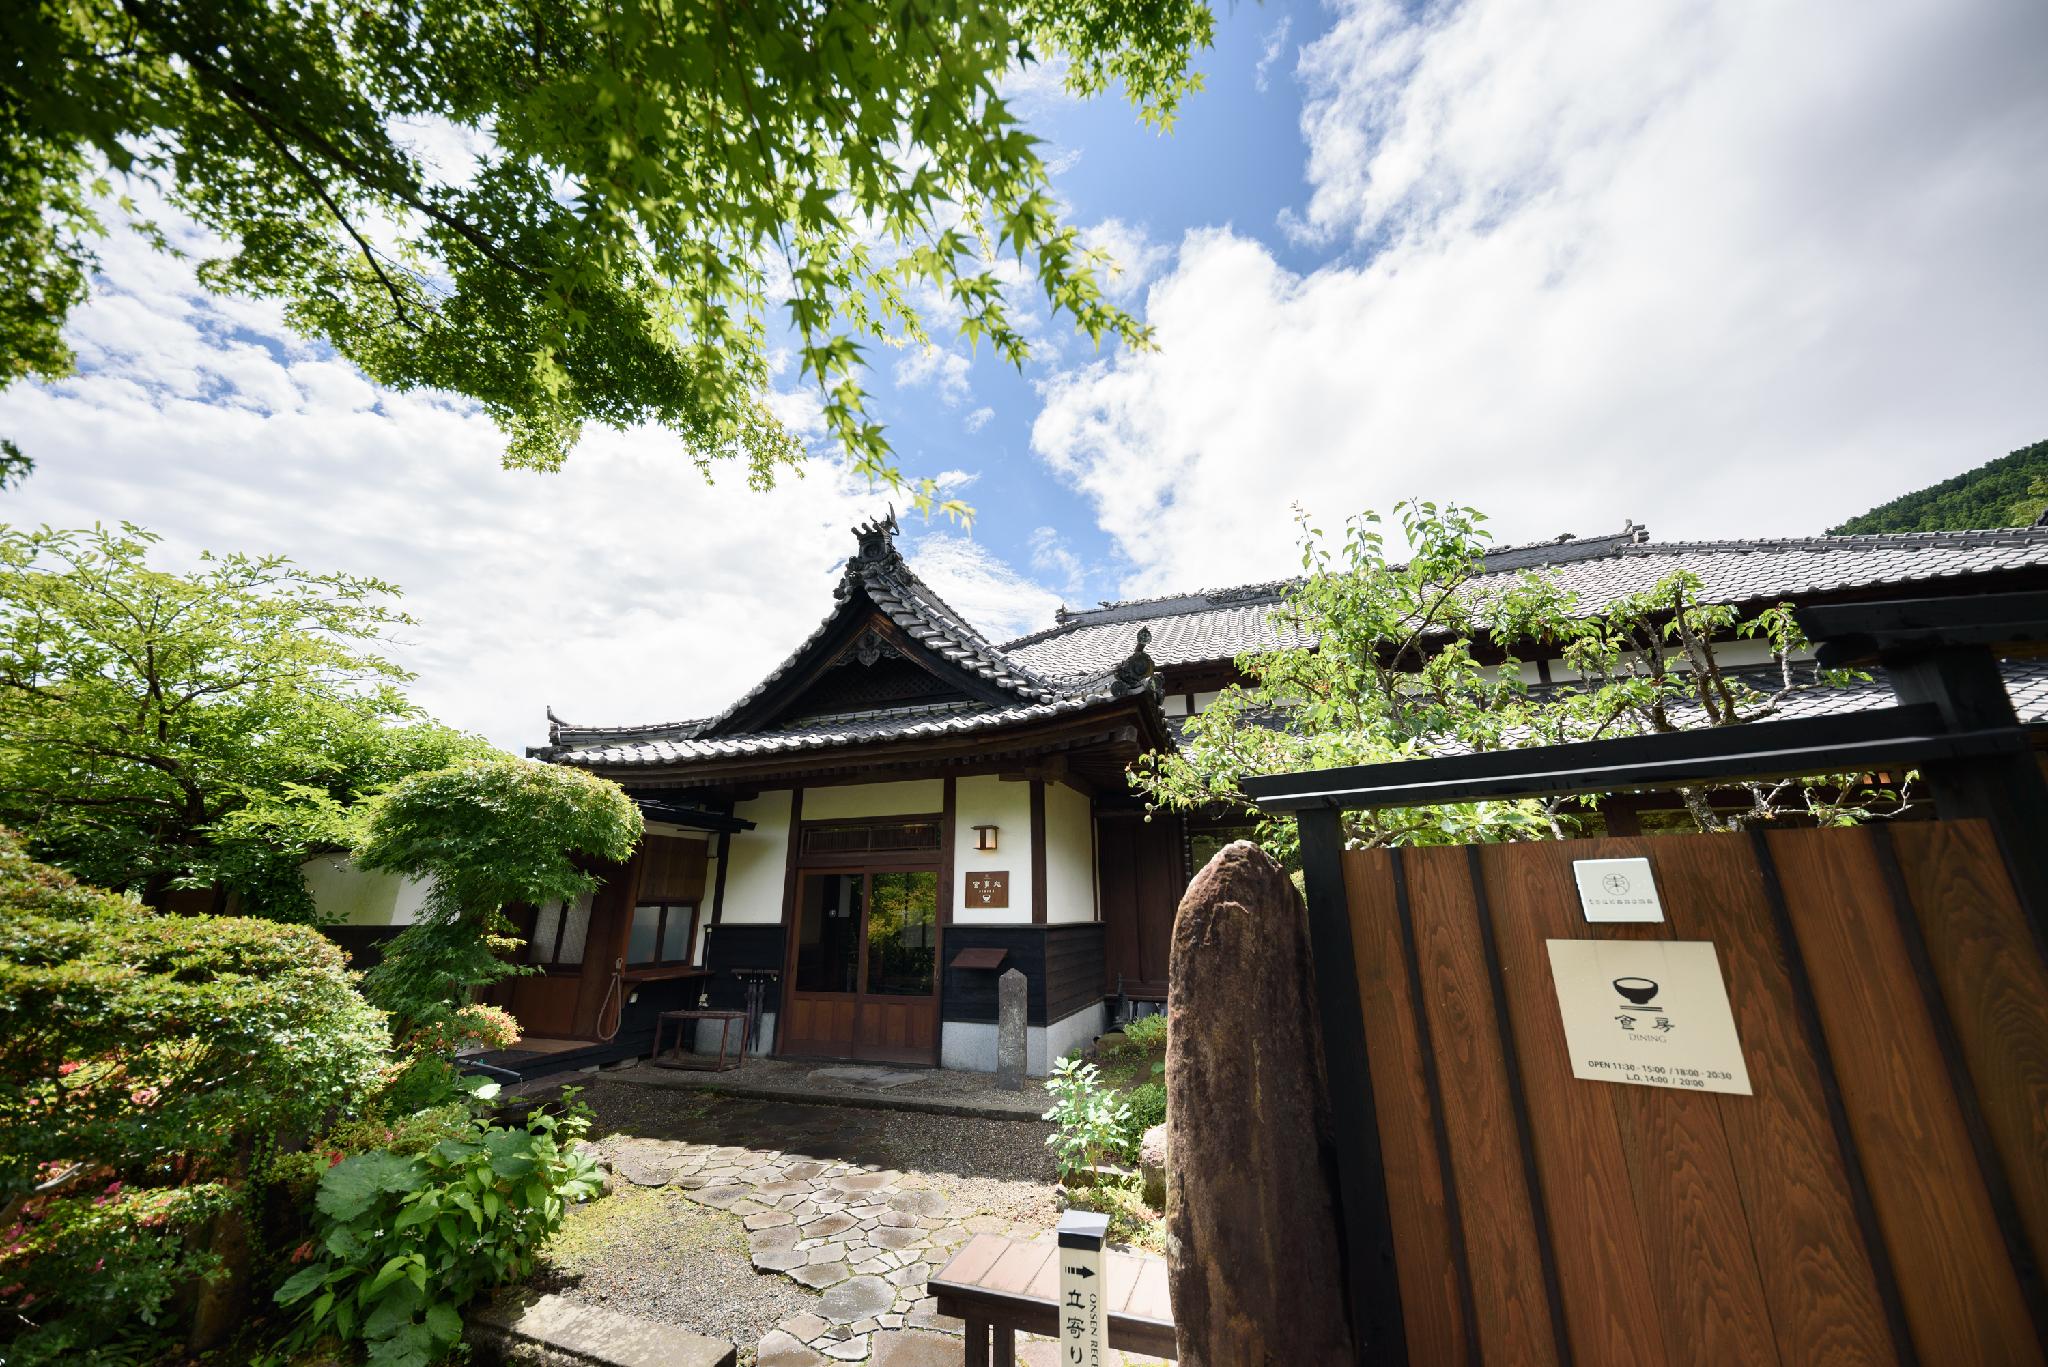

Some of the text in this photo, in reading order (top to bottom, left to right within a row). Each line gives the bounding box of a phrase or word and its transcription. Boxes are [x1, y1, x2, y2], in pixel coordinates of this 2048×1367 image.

[1628, 1033, 1668, 1043] DINING
[1588, 1060, 1611, 1069] OPEN
[1612, 1062, 1635, 1071] 11:30
[1641, 1064, 1666, 1074] 15:00
[1066, 1289, 1085, 1364] 立寄り
[1090, 1293, 1098, 1336] ONSEN
